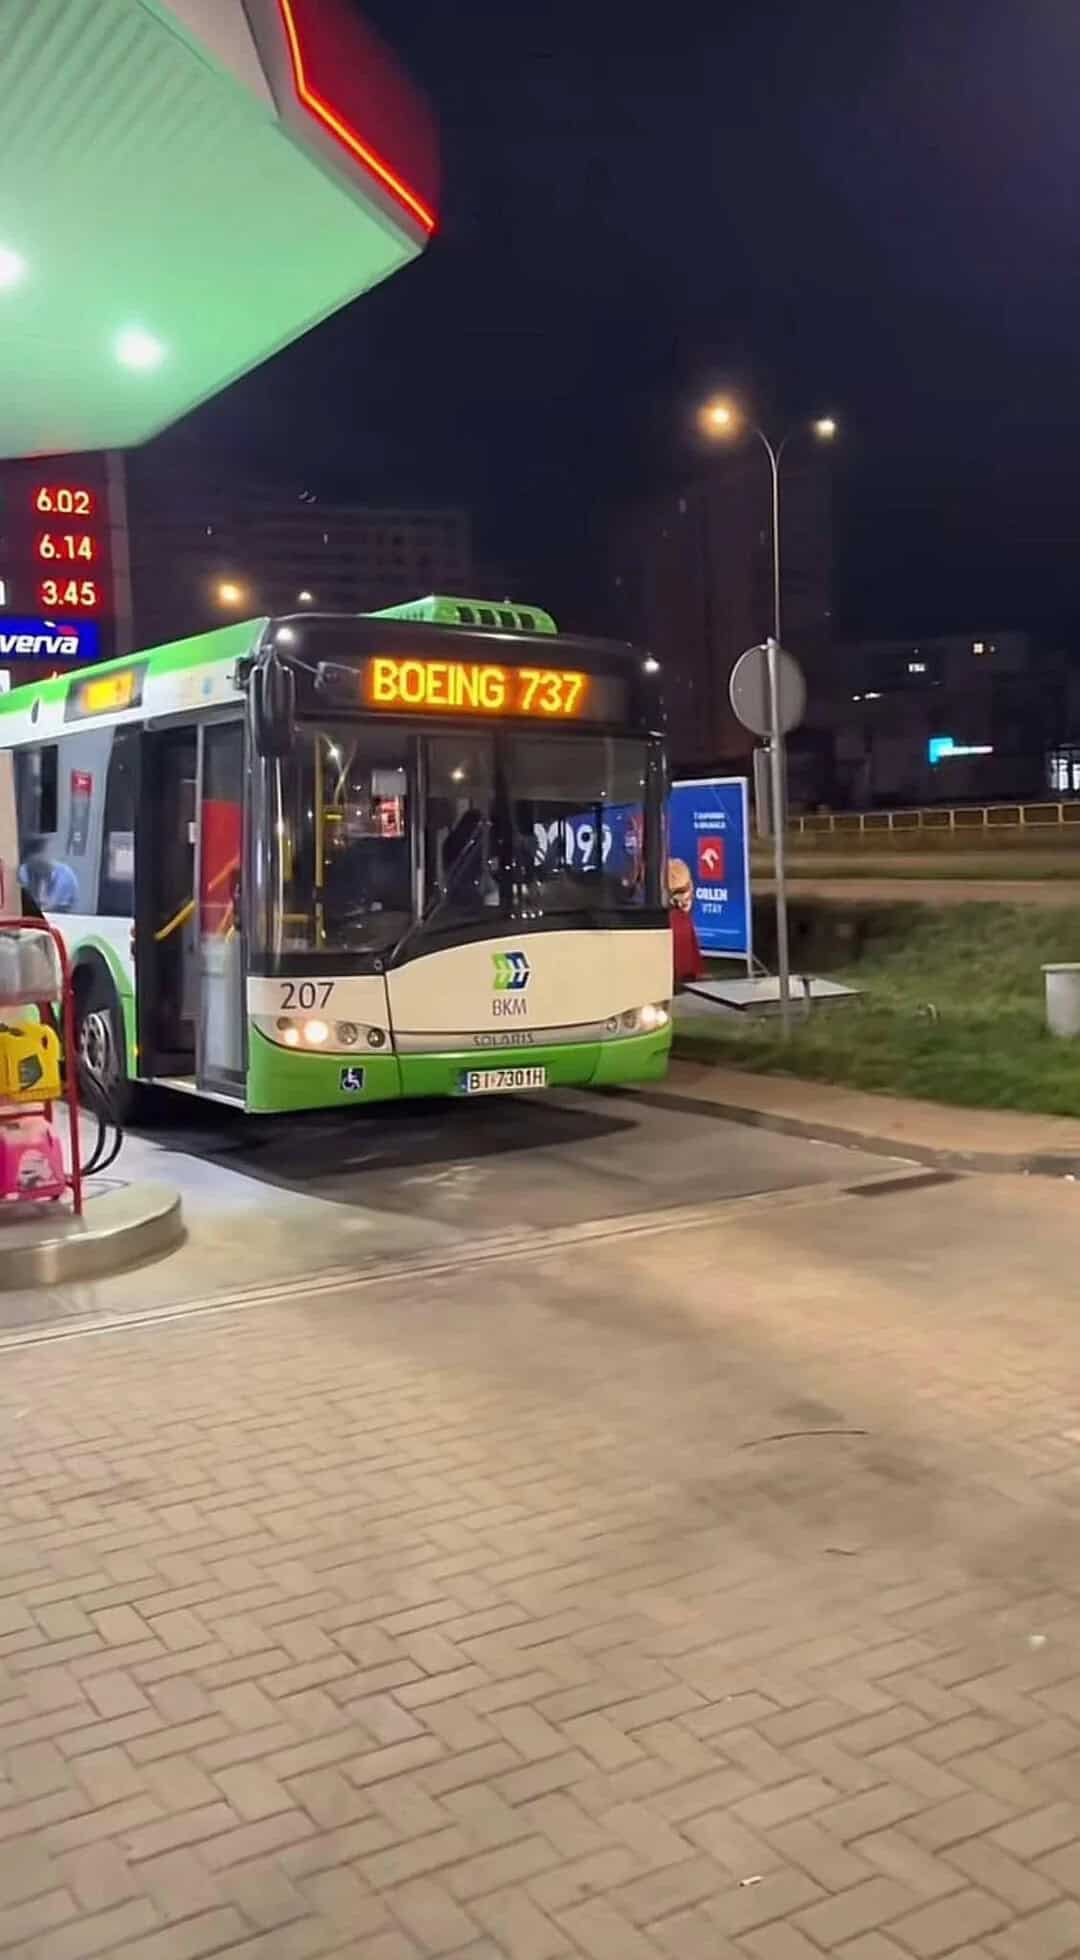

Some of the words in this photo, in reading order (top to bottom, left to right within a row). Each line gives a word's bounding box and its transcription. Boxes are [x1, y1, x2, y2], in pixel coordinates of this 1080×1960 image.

[37, 488, 90, 514] 6.02
[40, 534, 92, 560] 6.14
[42, 580, 96, 606] 3.45
[0, 635, 79, 654] verva
[373, 658, 505, 709] BOEING
[519, 669, 583, 713] 737
[280, 982, 335, 1010] 207
[492, 998, 528, 1017] BKM
[472, 1033, 534, 1046] SOLARIS
[496, 1069, 543, 1087] 7301H
